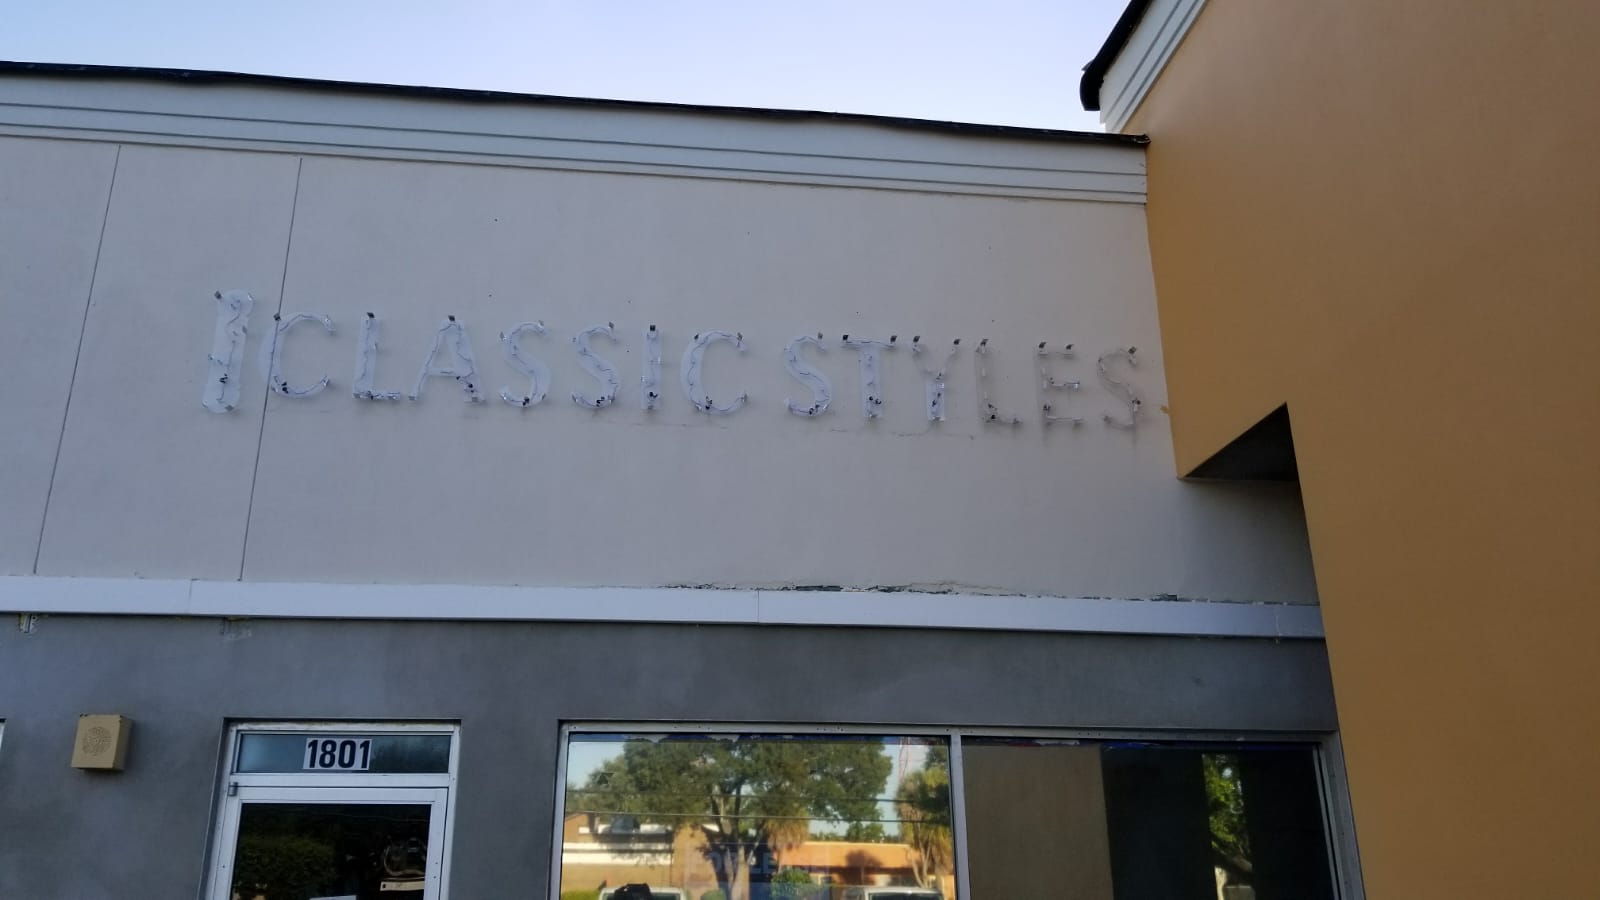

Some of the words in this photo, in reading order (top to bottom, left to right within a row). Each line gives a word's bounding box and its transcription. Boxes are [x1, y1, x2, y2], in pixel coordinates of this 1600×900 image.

[257, 310, 748, 415] CLASSIC
[783, 332, 1142, 430] STYLES
[307, 739, 371, 769] 1801
